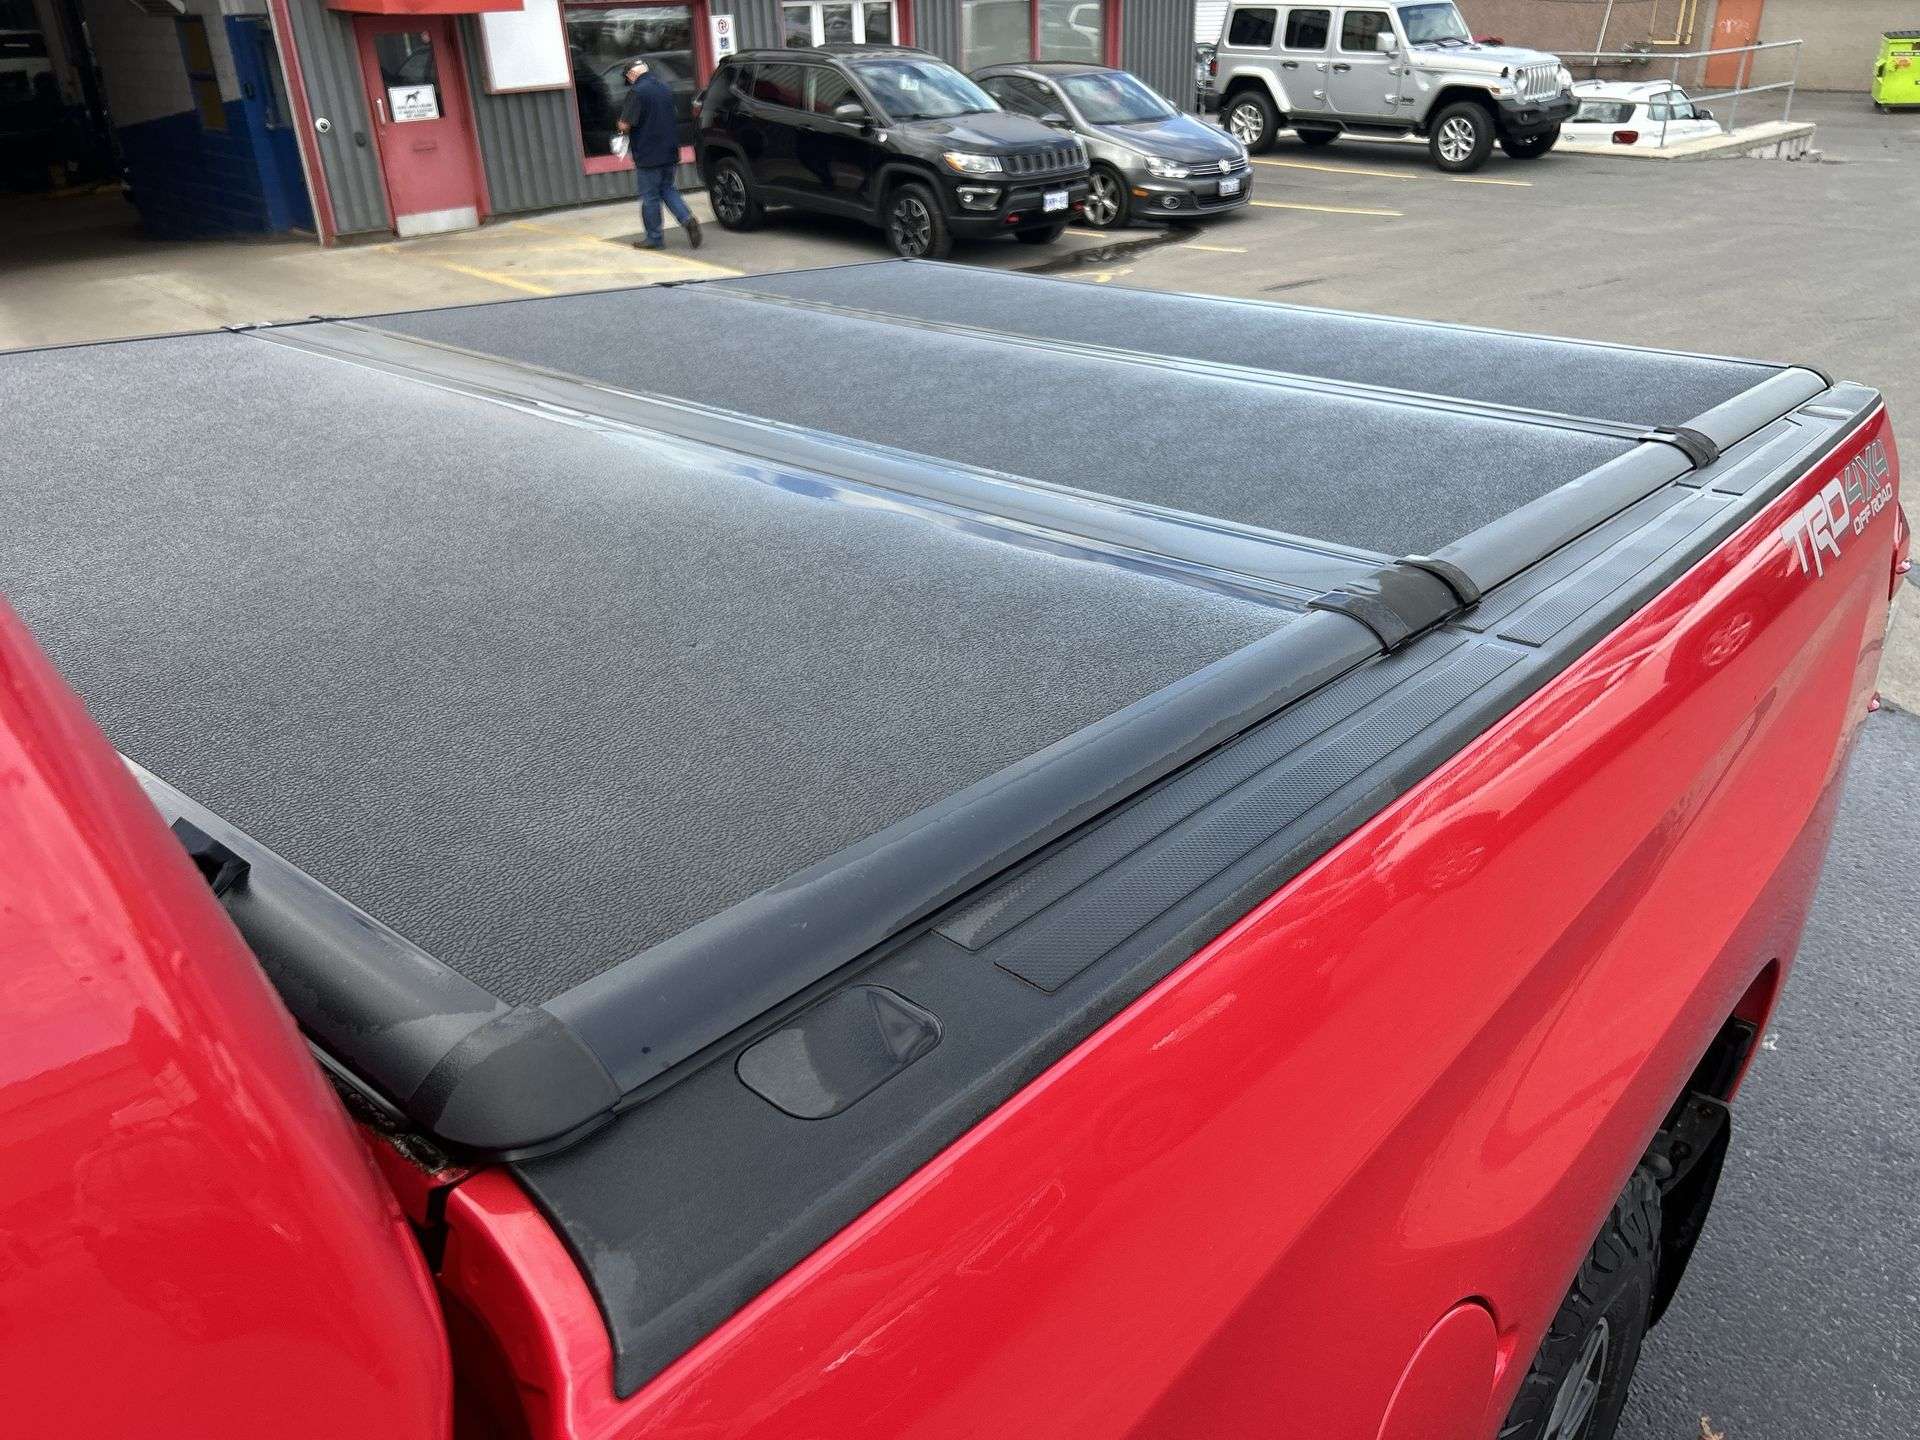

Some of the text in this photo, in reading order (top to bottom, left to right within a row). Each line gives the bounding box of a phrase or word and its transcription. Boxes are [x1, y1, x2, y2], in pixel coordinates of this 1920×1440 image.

[1780, 439, 1889, 577] TRD 4X4
[1853, 482, 1893, 535] OFF ROAD
